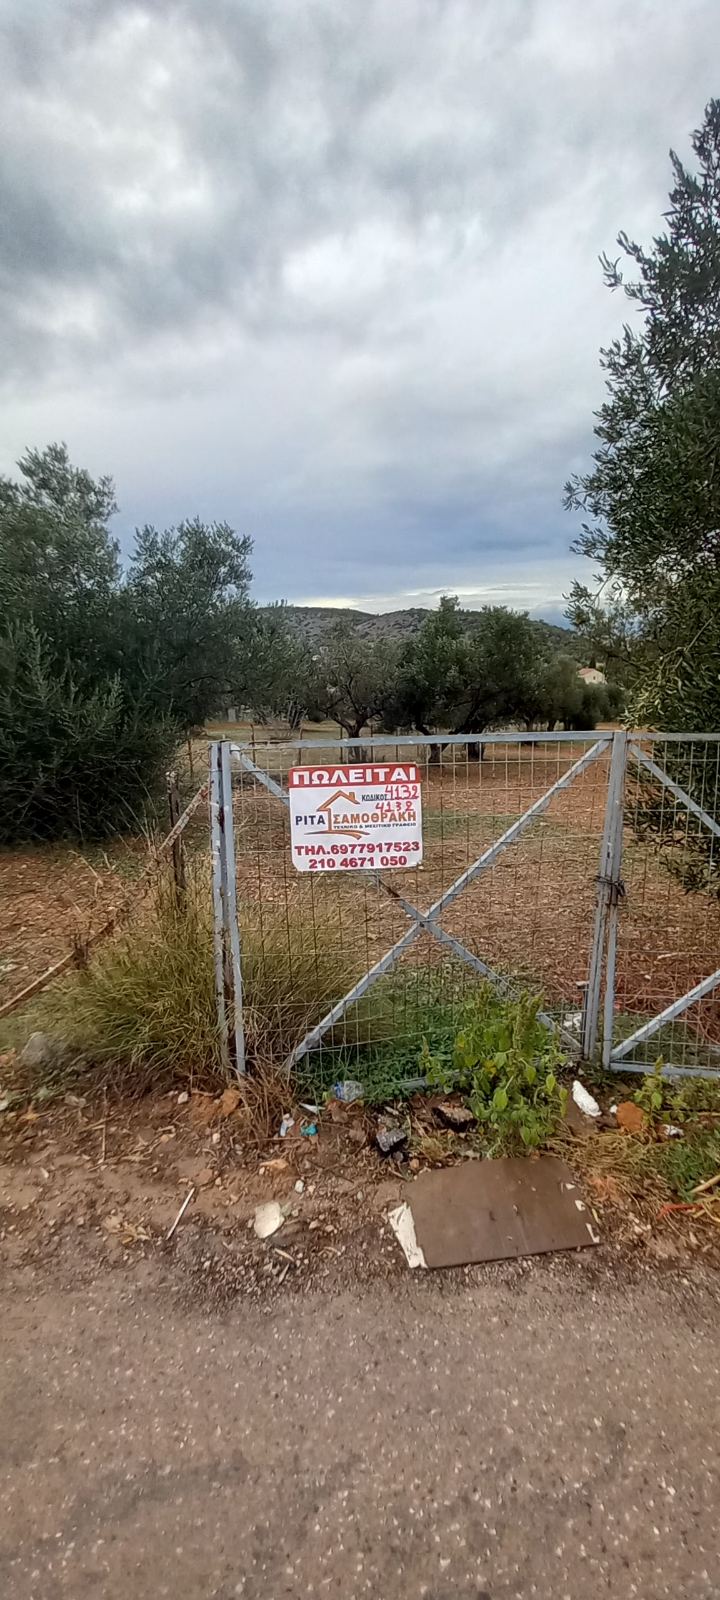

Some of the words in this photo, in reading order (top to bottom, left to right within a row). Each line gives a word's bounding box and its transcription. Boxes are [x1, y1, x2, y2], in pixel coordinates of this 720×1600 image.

[293, 768, 416, 784] ΠΩΛΕΙΤΑΙ
[385, 785, 419, 800] 4132
[376, 801, 414, 812] 4132
[296, 815, 325, 825] ΡΙΤΑ
[333, 812, 416, 824] ΣΑΜΟΘΡΑΚΗ
[294, 842, 419, 855] ΤΗΛ.6977917523
[309, 858, 335, 869] 210
[340, 857, 374, 868] 4671
[380, 856, 407, 866] 050
